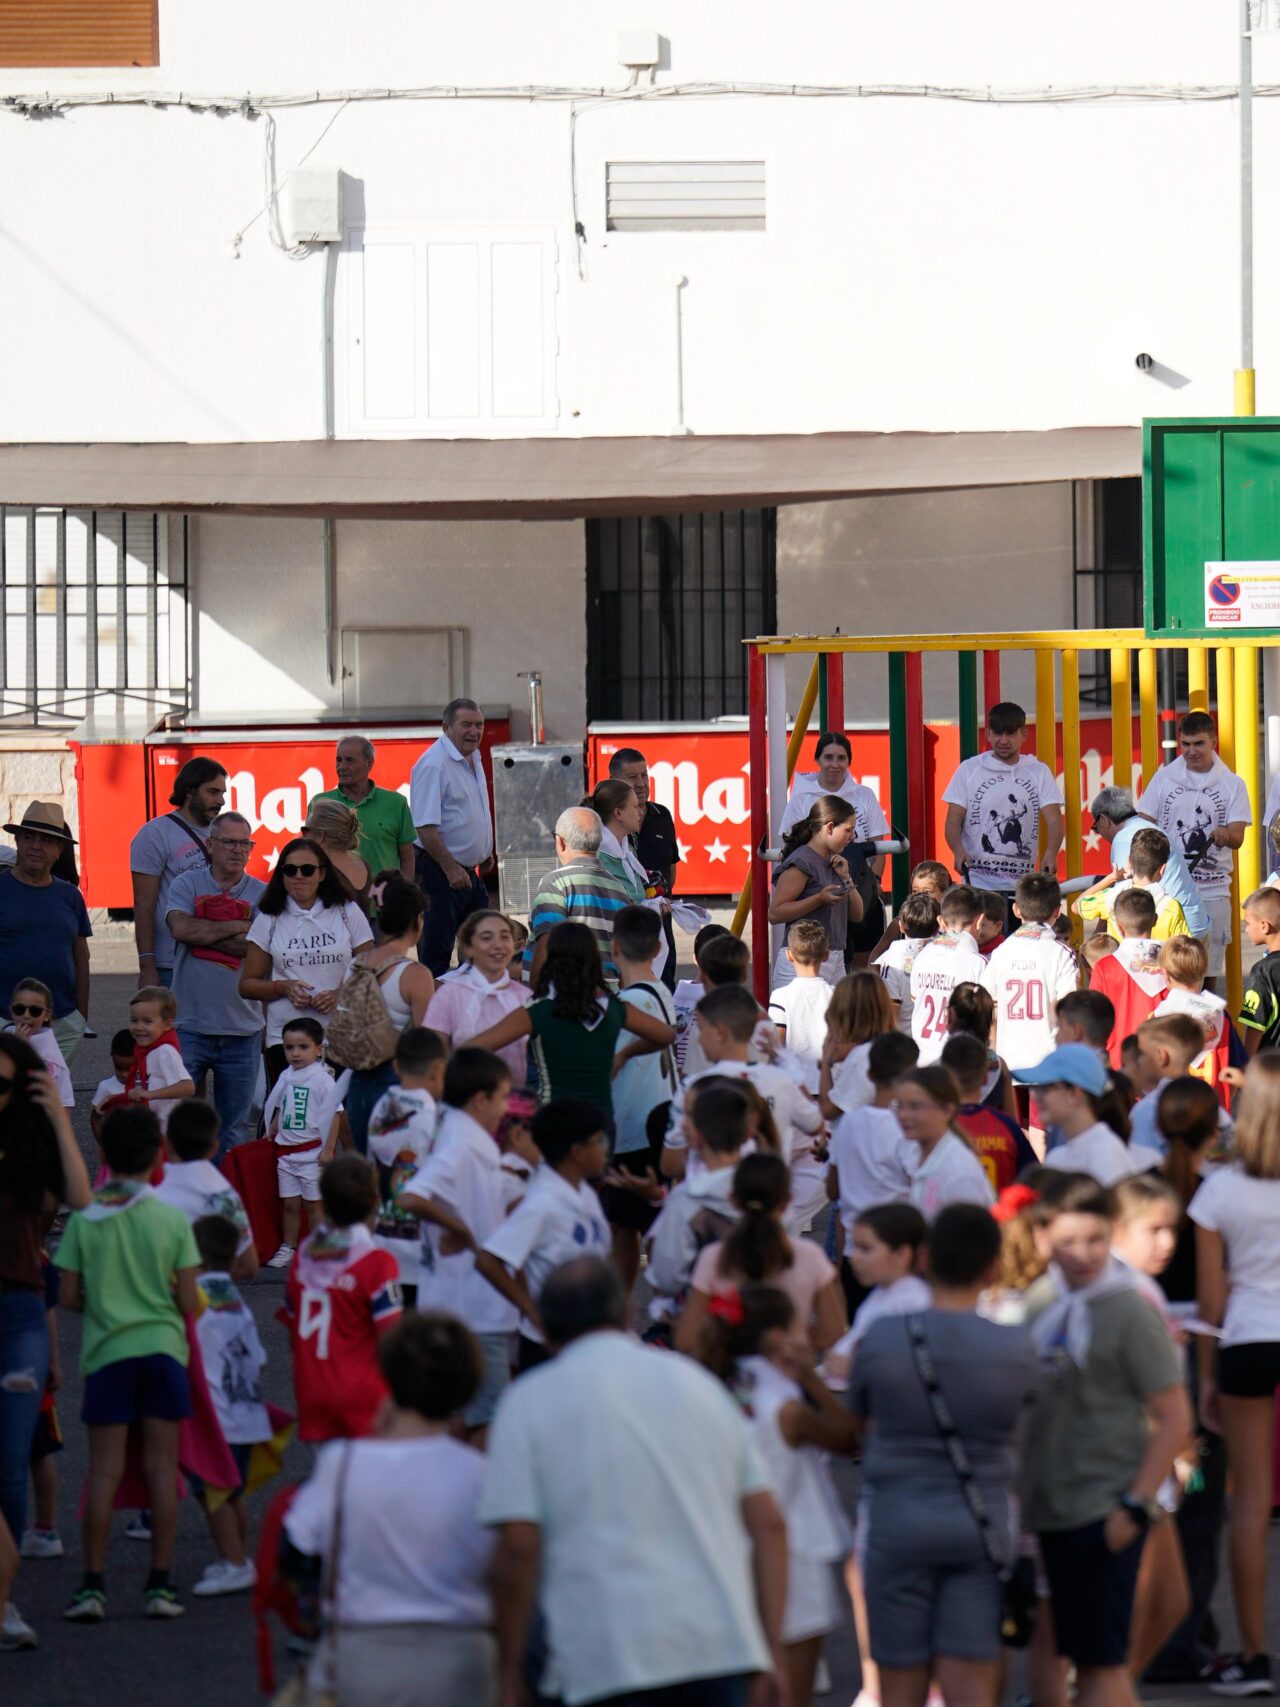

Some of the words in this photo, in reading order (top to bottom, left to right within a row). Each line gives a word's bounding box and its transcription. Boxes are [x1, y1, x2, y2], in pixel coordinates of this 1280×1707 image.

[970, 774, 1004, 826] Encierros
[281, 952, 294, 970] je
[299, 949, 344, 967] t'aime
[287, 932, 337, 950] PARIS
[1006, 979, 1044, 1020] 20
[298, 1284, 331, 1361] 9
